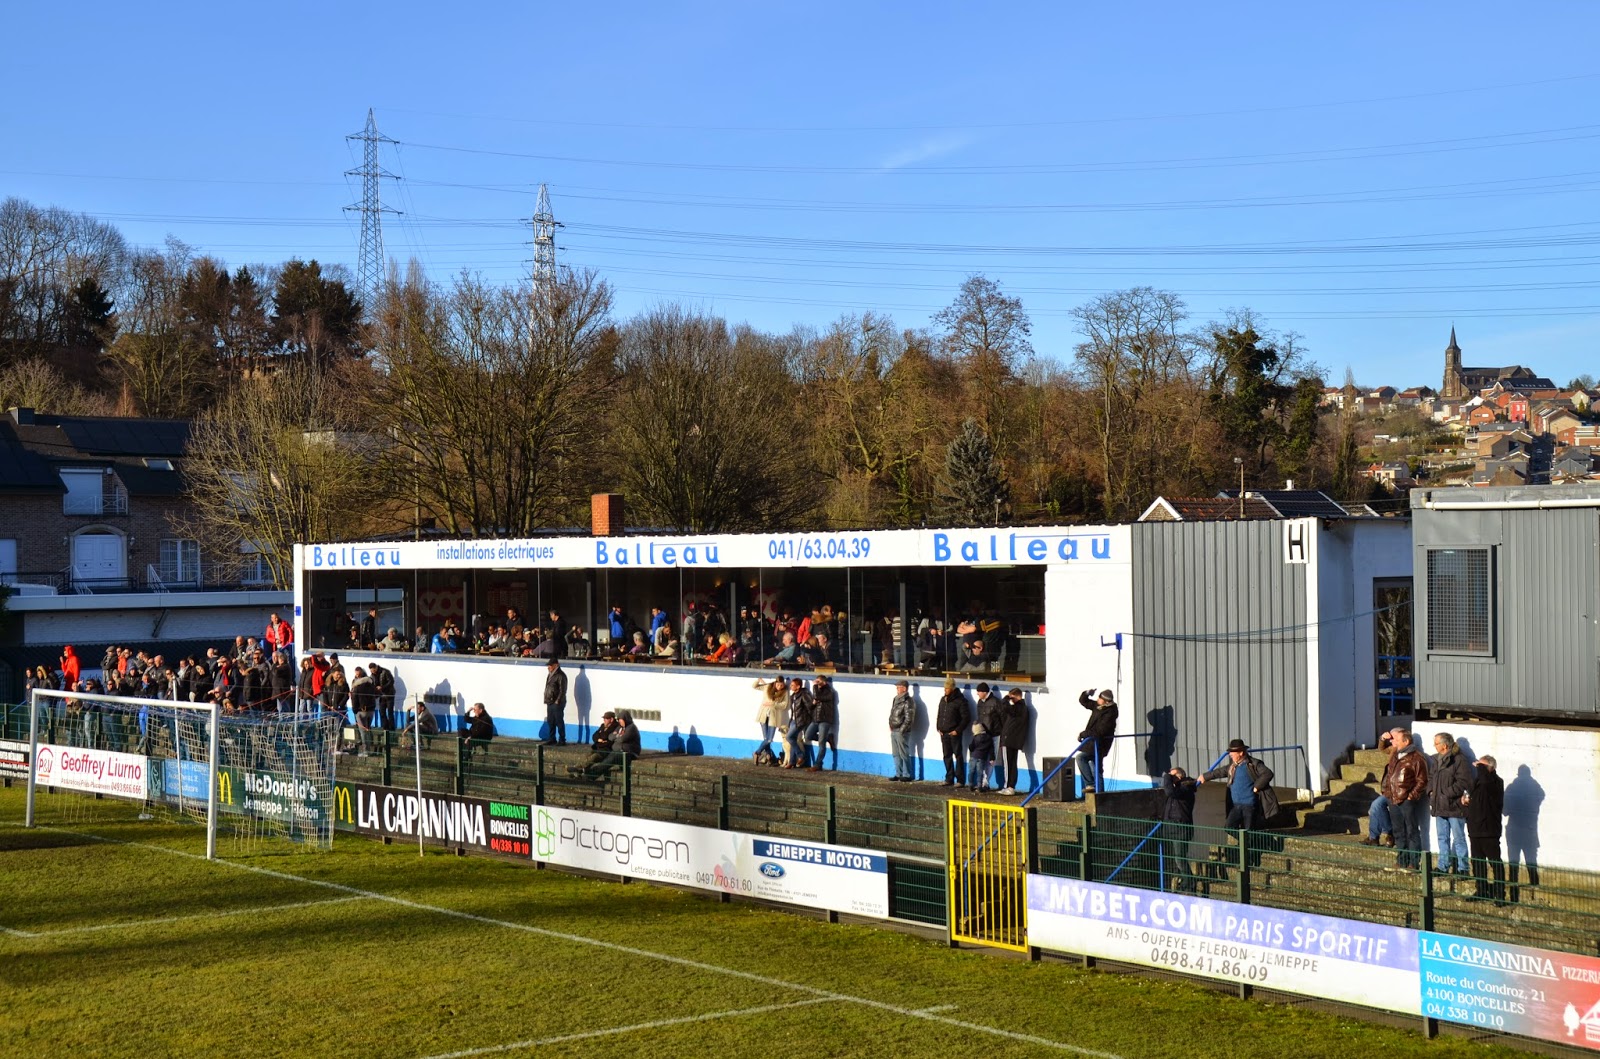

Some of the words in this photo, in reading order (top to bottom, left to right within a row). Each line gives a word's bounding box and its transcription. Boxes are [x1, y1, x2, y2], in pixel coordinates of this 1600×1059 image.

[436, 542, 496, 560] installations
[498, 541, 554, 563] électriques
[596, 540, 720, 565] Balleau
[768, 537, 871, 561] 041/63.04.39
[933, 533, 1112, 562] Balleau
[1288, 523, 1304, 560] H
[313, 546, 401, 567] Balleau
[61, 751, 106, 781] Geoffrey
[107, 757, 142, 780] Liurno
[245, 773, 317, 801] McDonald's
[243, 796, 283, 816] Jemeppe
[357, 789, 380, 830] LA
[383, 792, 487, 846] CAPANNINA
[490, 802, 529, 820] RISTORANTE
[490, 819, 529, 839] BONCELLES
[560, 817, 690, 864] Pictogram
[513, 841, 521, 854] 10
[522, 842, 529, 855] 10
[766, 843, 822, 863] JEMEPPE
[826, 851, 872, 870] MOTOR
[630, 863, 657, 877] Lettrage
[658, 866, 691, 881] publicitaire
[696, 871, 753, 892] 0497/70.61.60
[763, 864, 781, 878] Ford
[1049, 883, 1213, 934] MYBET.COM
[1225, 915, 1285, 945] PARIS
[1291, 926, 1389, 961] SPORTIF
[1106, 926, 1130, 941] ANS
[1141, 931, 1188, 950] OUPEYE
[1199, 941, 1248, 961] FLERON
[1259, 951, 1319, 973] JEMEPPE
[1421, 938, 1445, 958] LA
[1448, 943, 1557, 977] CAPANNINA
[1562, 965, 1600, 985] PIZZERI
[1150, 948, 1268, 982] 0498.41.86.09
[1426, 971, 1457, 987] Route
[1460, 977, 1475, 990] du
[1477, 979, 1528, 1001] Condroz,
[1531, 988, 1546, 1002] 21
[1426, 987, 1455, 1001] 4100
[1457, 991, 1526, 1015] BONCELLES
[1427, 1002, 1445, 1016] 04/
[1447, 1006, 1469, 1020] 338
[1472, 1011, 1486, 1024] 10
[1490, 1014, 1504, 1028] 10
